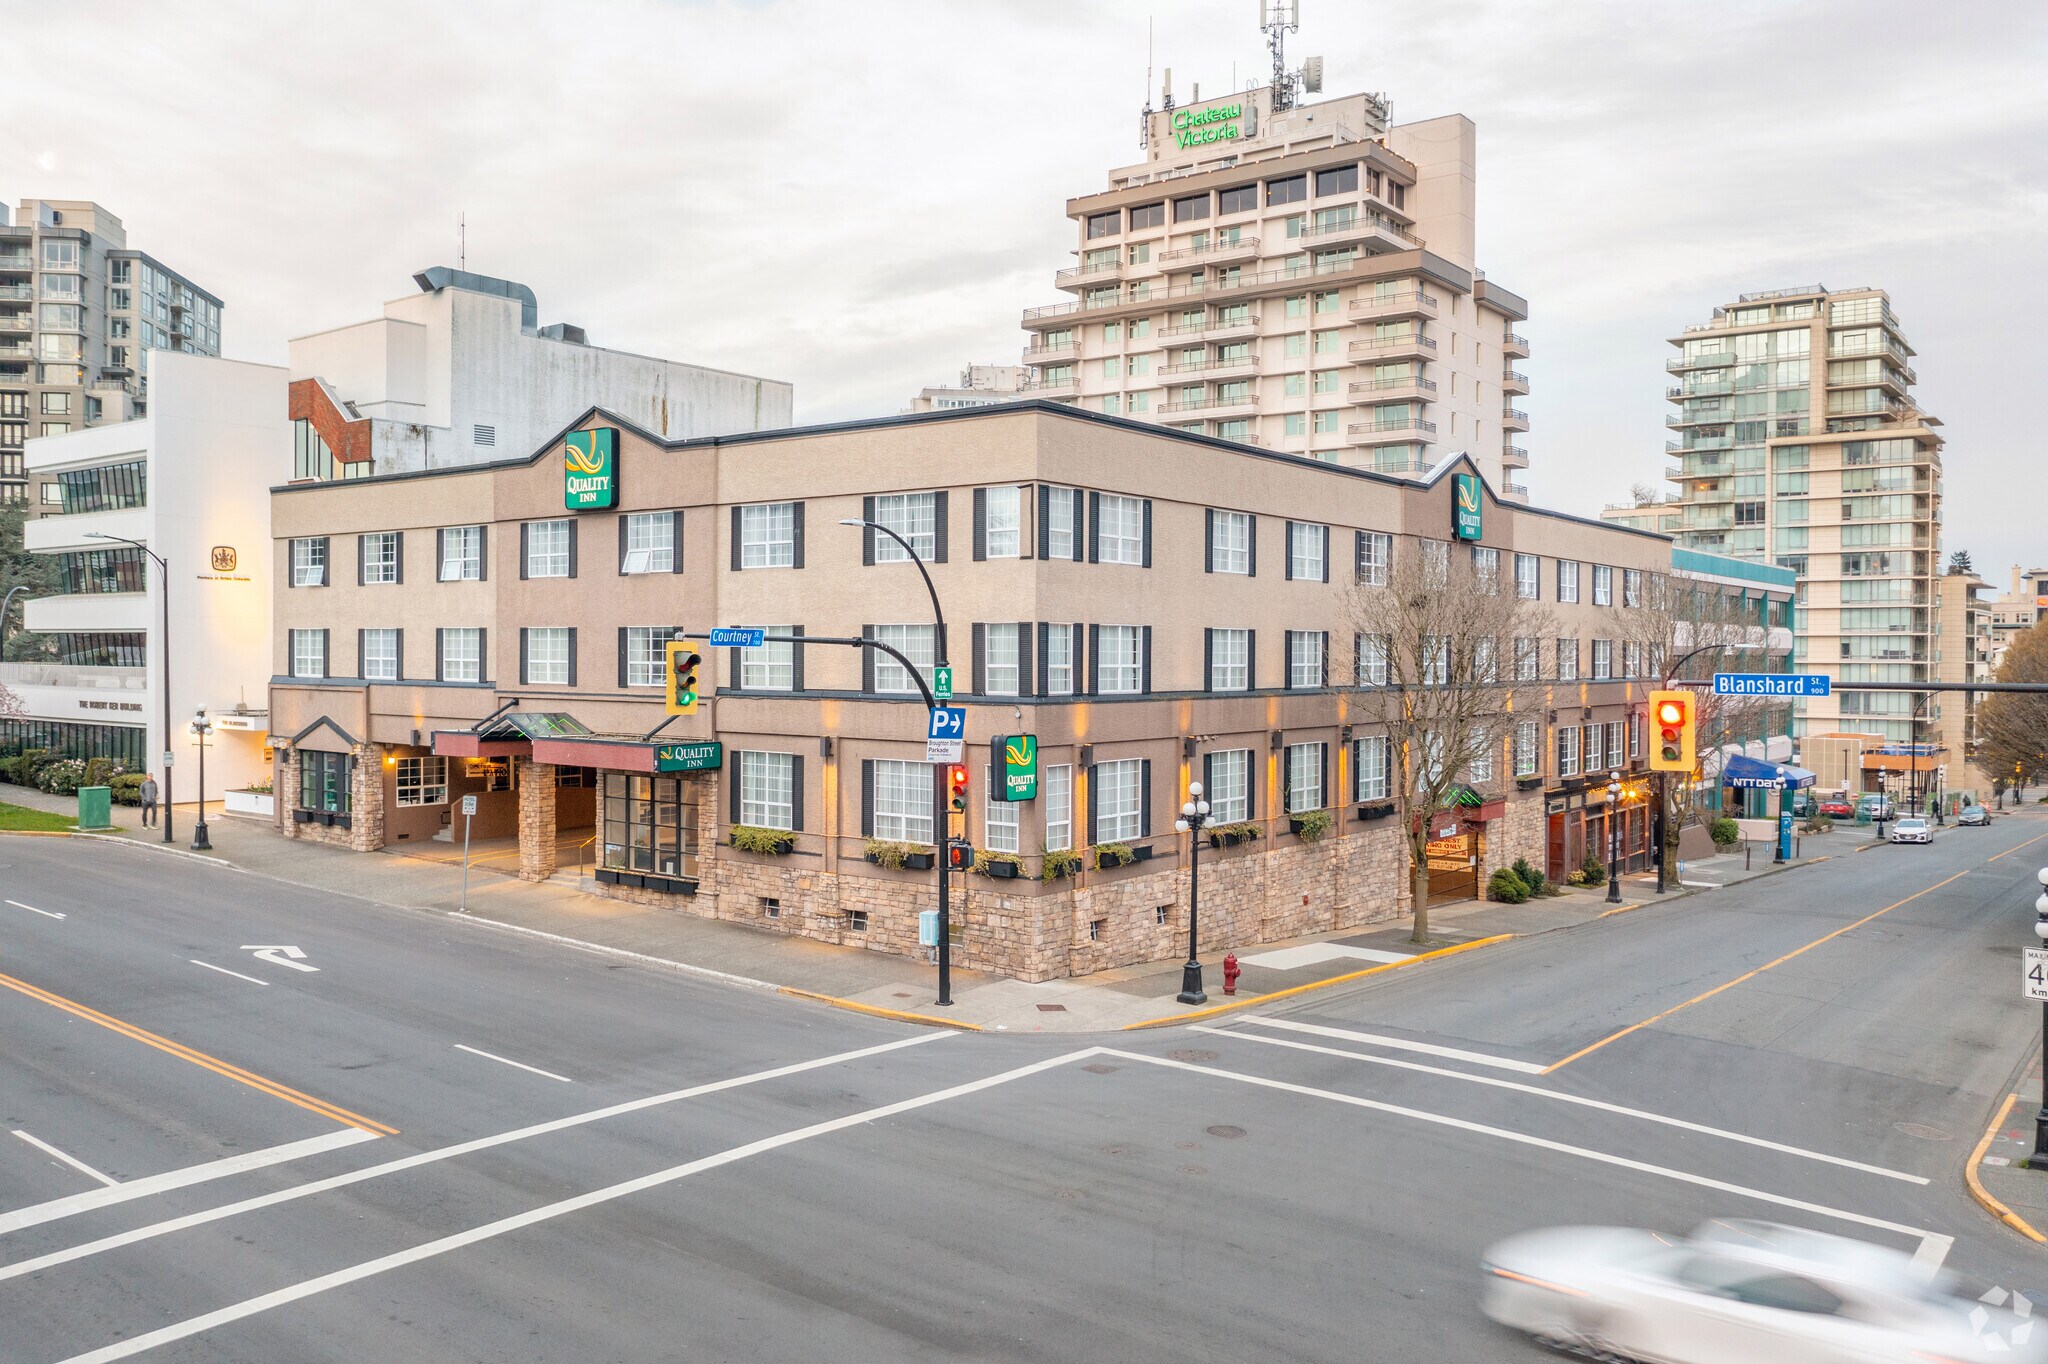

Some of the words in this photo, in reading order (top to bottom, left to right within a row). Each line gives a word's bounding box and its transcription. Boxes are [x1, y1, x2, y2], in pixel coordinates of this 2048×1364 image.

[1172, 103, 1241, 130] Chateau
[1174, 123, 1239, 149] Victoria
[567, 476, 610, 494] QUALITY
[579, 493, 597, 502] INN
[1460, 511, 1480, 527] QUALITY
[712, 630, 752, 645] Courtney
[1719, 676, 1804, 694] Blanshard
[932, 710, 949, 736] P
[675, 747, 714, 761] QUALITY
[1007, 774, 1035, 787] QUALITY
[1015, 785, 1027, 793] INN
